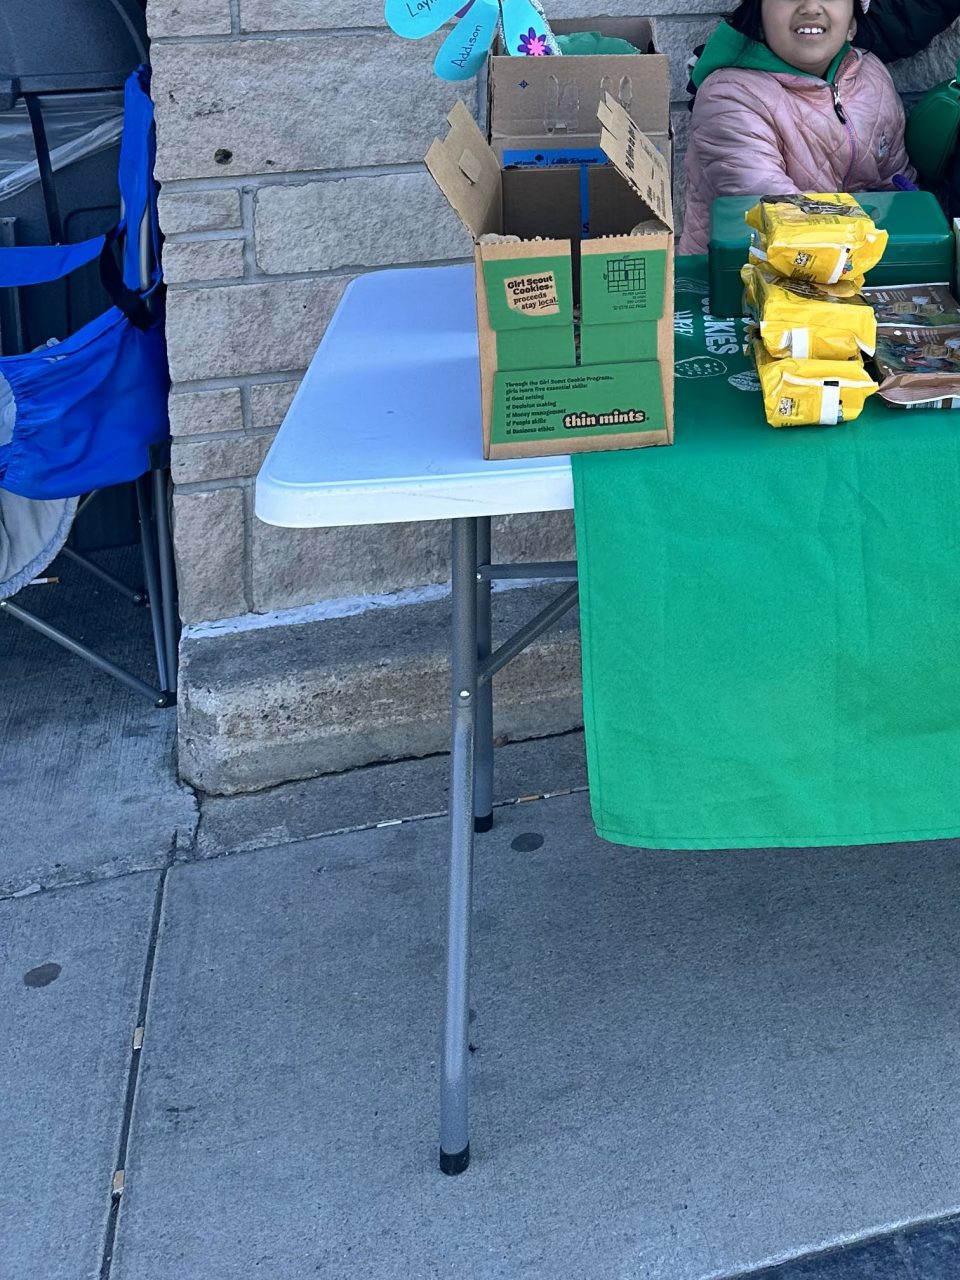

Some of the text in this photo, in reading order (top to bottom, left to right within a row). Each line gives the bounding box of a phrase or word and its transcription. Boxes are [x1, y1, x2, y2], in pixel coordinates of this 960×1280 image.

[451, 24, 483, 68] Addison
[507, 275, 553, 289] Girl Scout
[513, 292, 547, 305] proceeds
[521, 301, 537, 309] stay
[505, 380, 528, 389] Through
[525, 393, 545, 401] setting
[512, 408, 567, 419] Money management
[565, 410, 644, 427] thin mints
